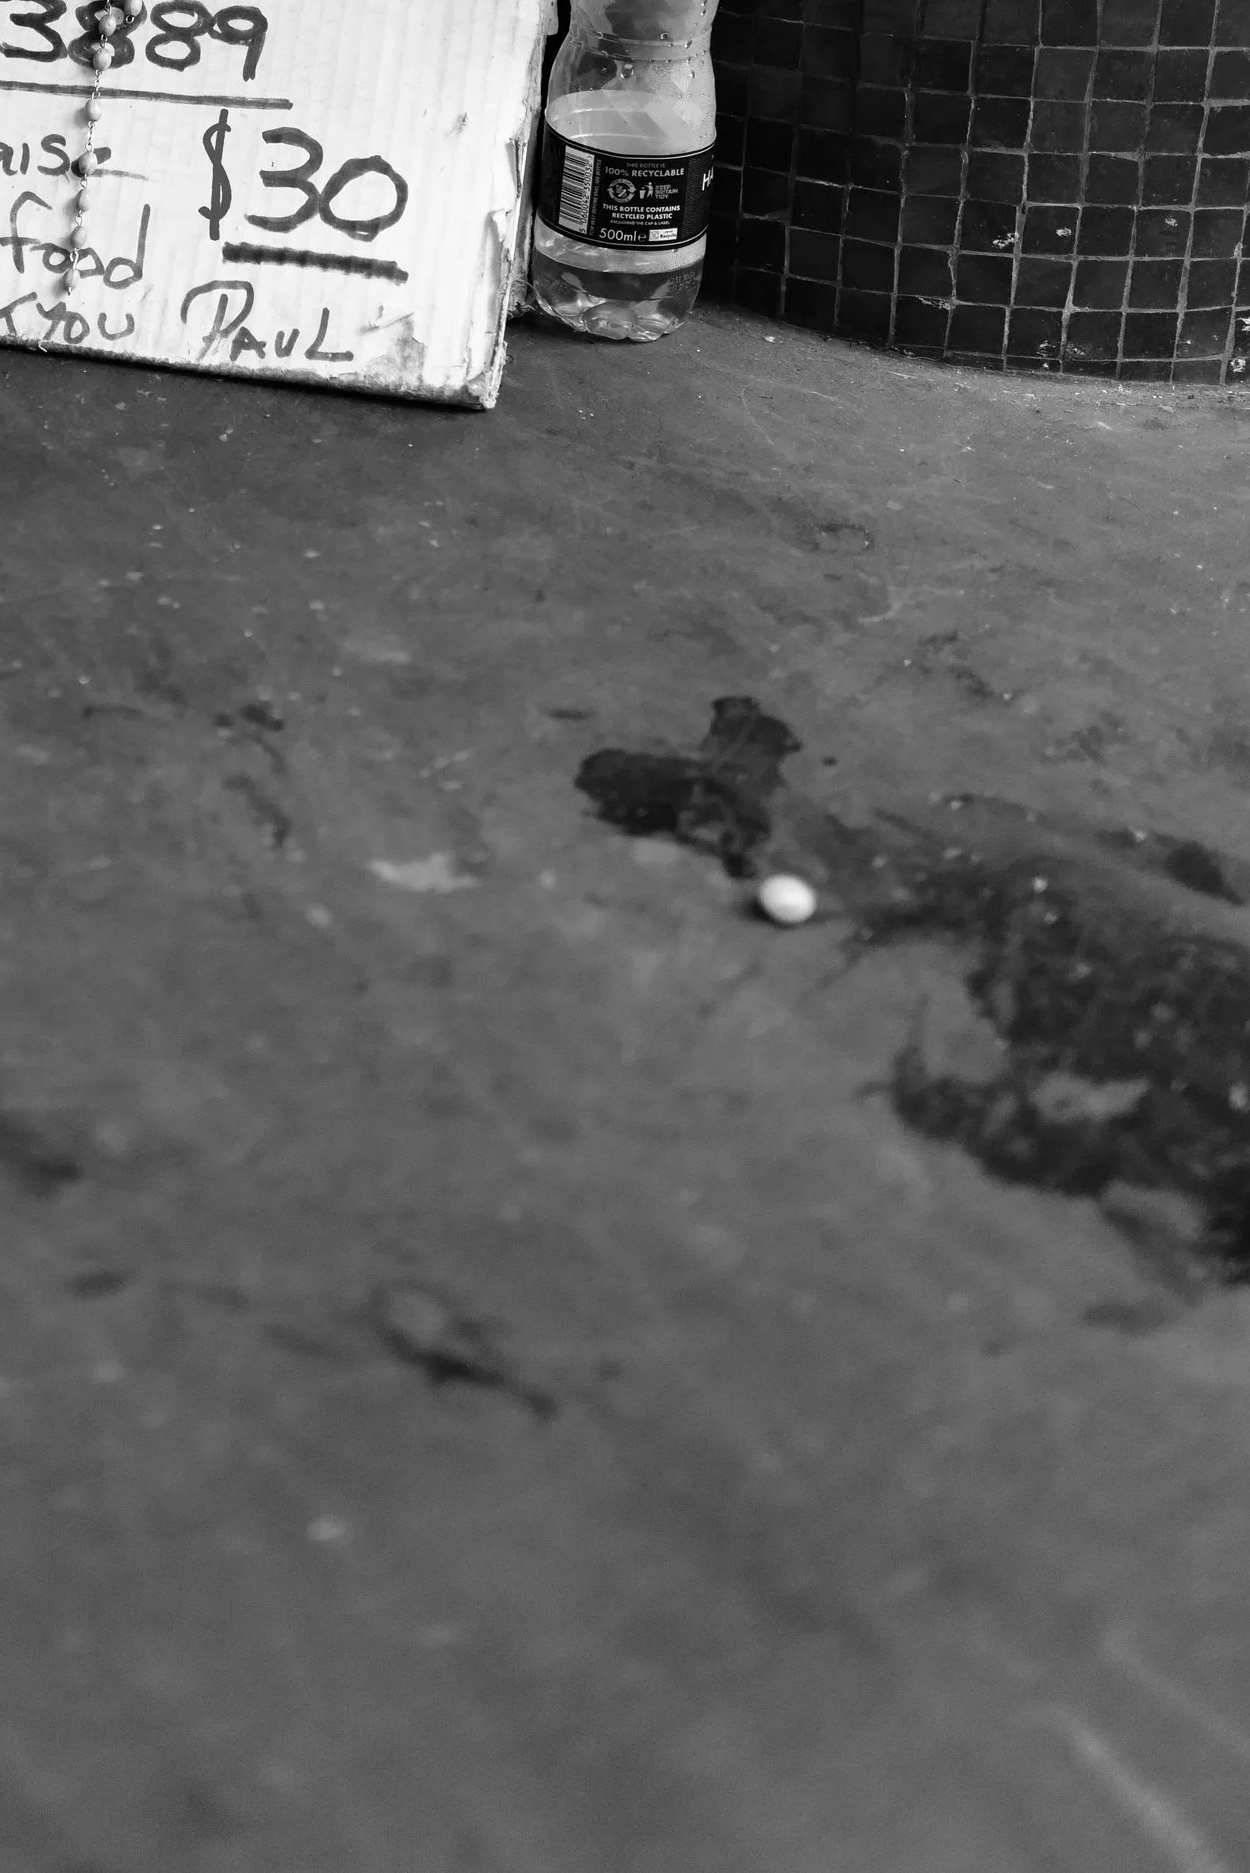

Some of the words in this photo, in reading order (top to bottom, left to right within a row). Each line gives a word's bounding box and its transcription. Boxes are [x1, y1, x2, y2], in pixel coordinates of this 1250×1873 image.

[198, 109, 409, 242] $30
[605, 166, 629, 177] 100%
[631, 168, 685, 177] RECYCLABLE
[603, 203, 618, 211] THIS
[645, 205, 681, 213] CONTAINS
[612, 212, 645, 220] RECYCLED
[646, 212, 673, 220] PLASTIC
